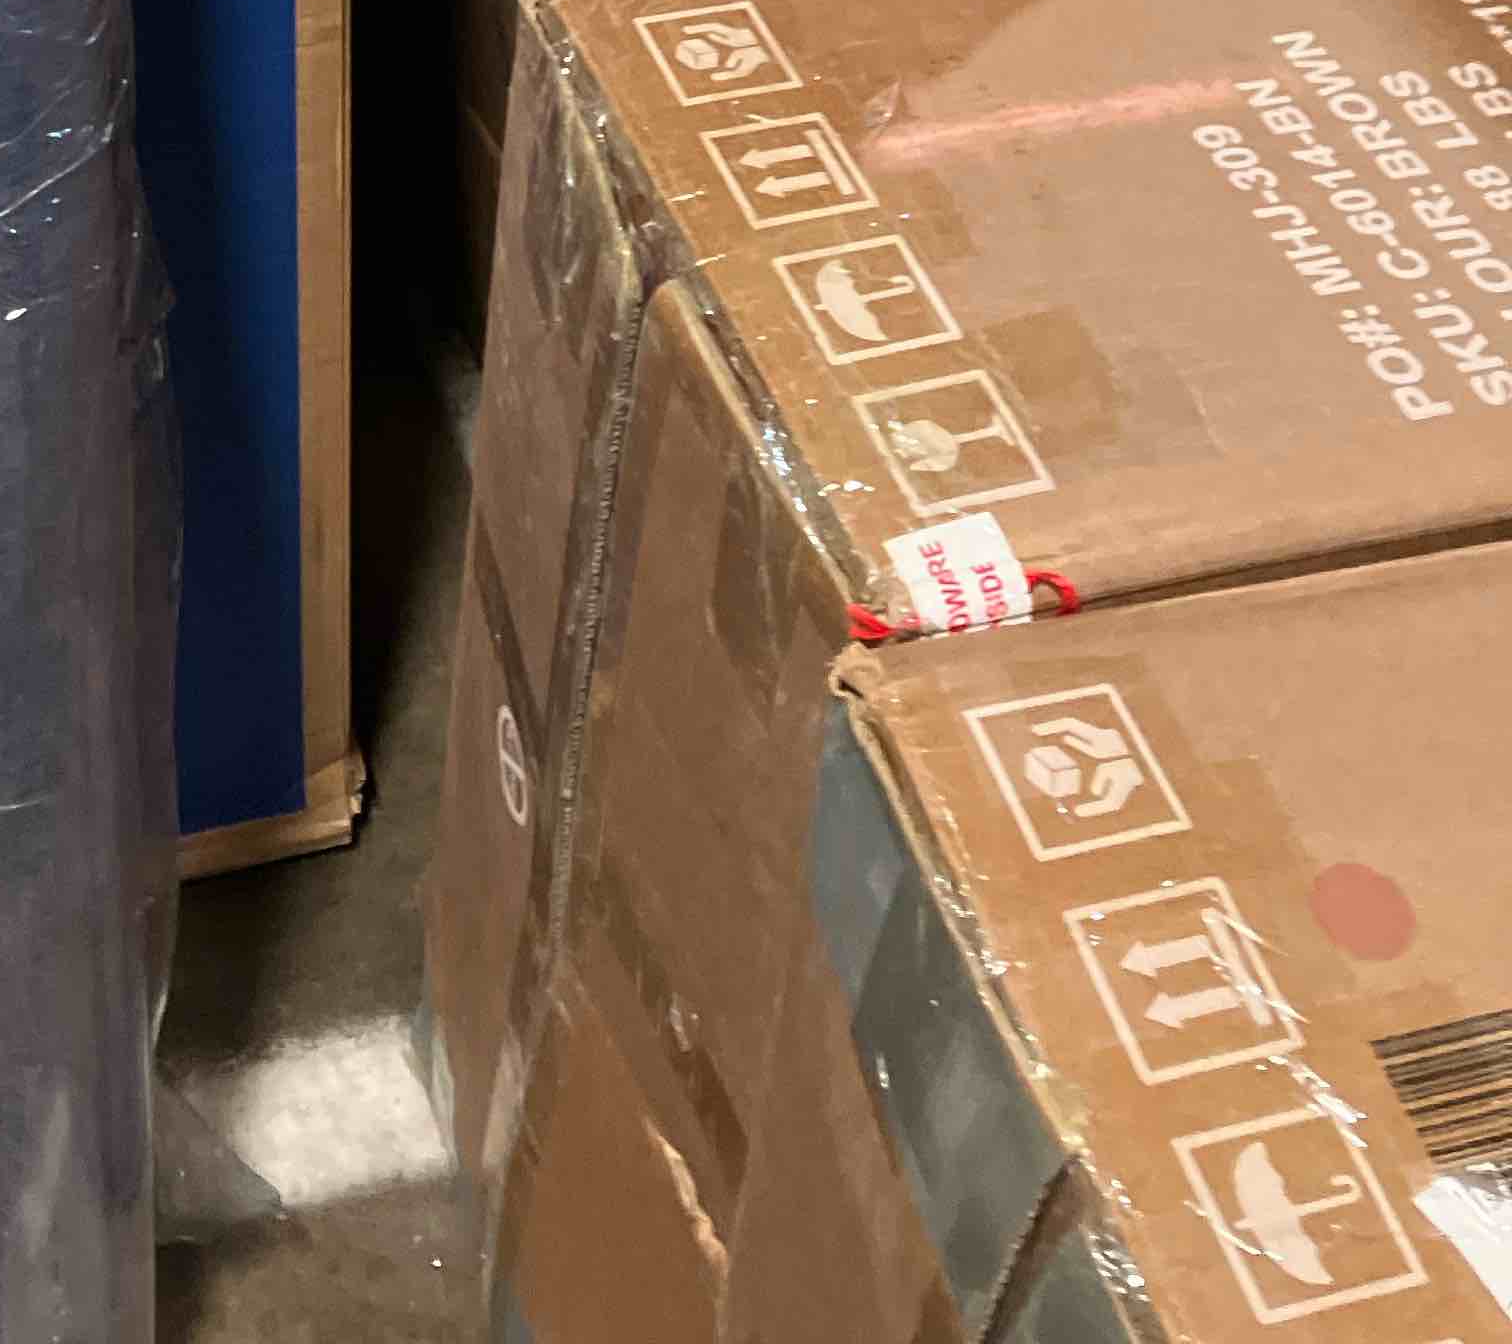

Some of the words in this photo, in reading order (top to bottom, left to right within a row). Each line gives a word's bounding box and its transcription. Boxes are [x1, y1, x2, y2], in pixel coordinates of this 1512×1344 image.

[1271, 30, 1431, 180] BROWN
[1378, 70, 1480, 150] LBS
[1447, 61, 1512, 138] BS
[1192, 124, 1363, 296] MHJ-309
[1235, 78, 1430, 280] C-6014-BN
[1414, 183, 1512, 320] OUR:
[1337, 304, 1455, 421] PO#:
[1412, 287, 1512, 406] SKU:
[918, 540, 974, 632] DWARE
[970, 561, 1009, 620] SIDE
